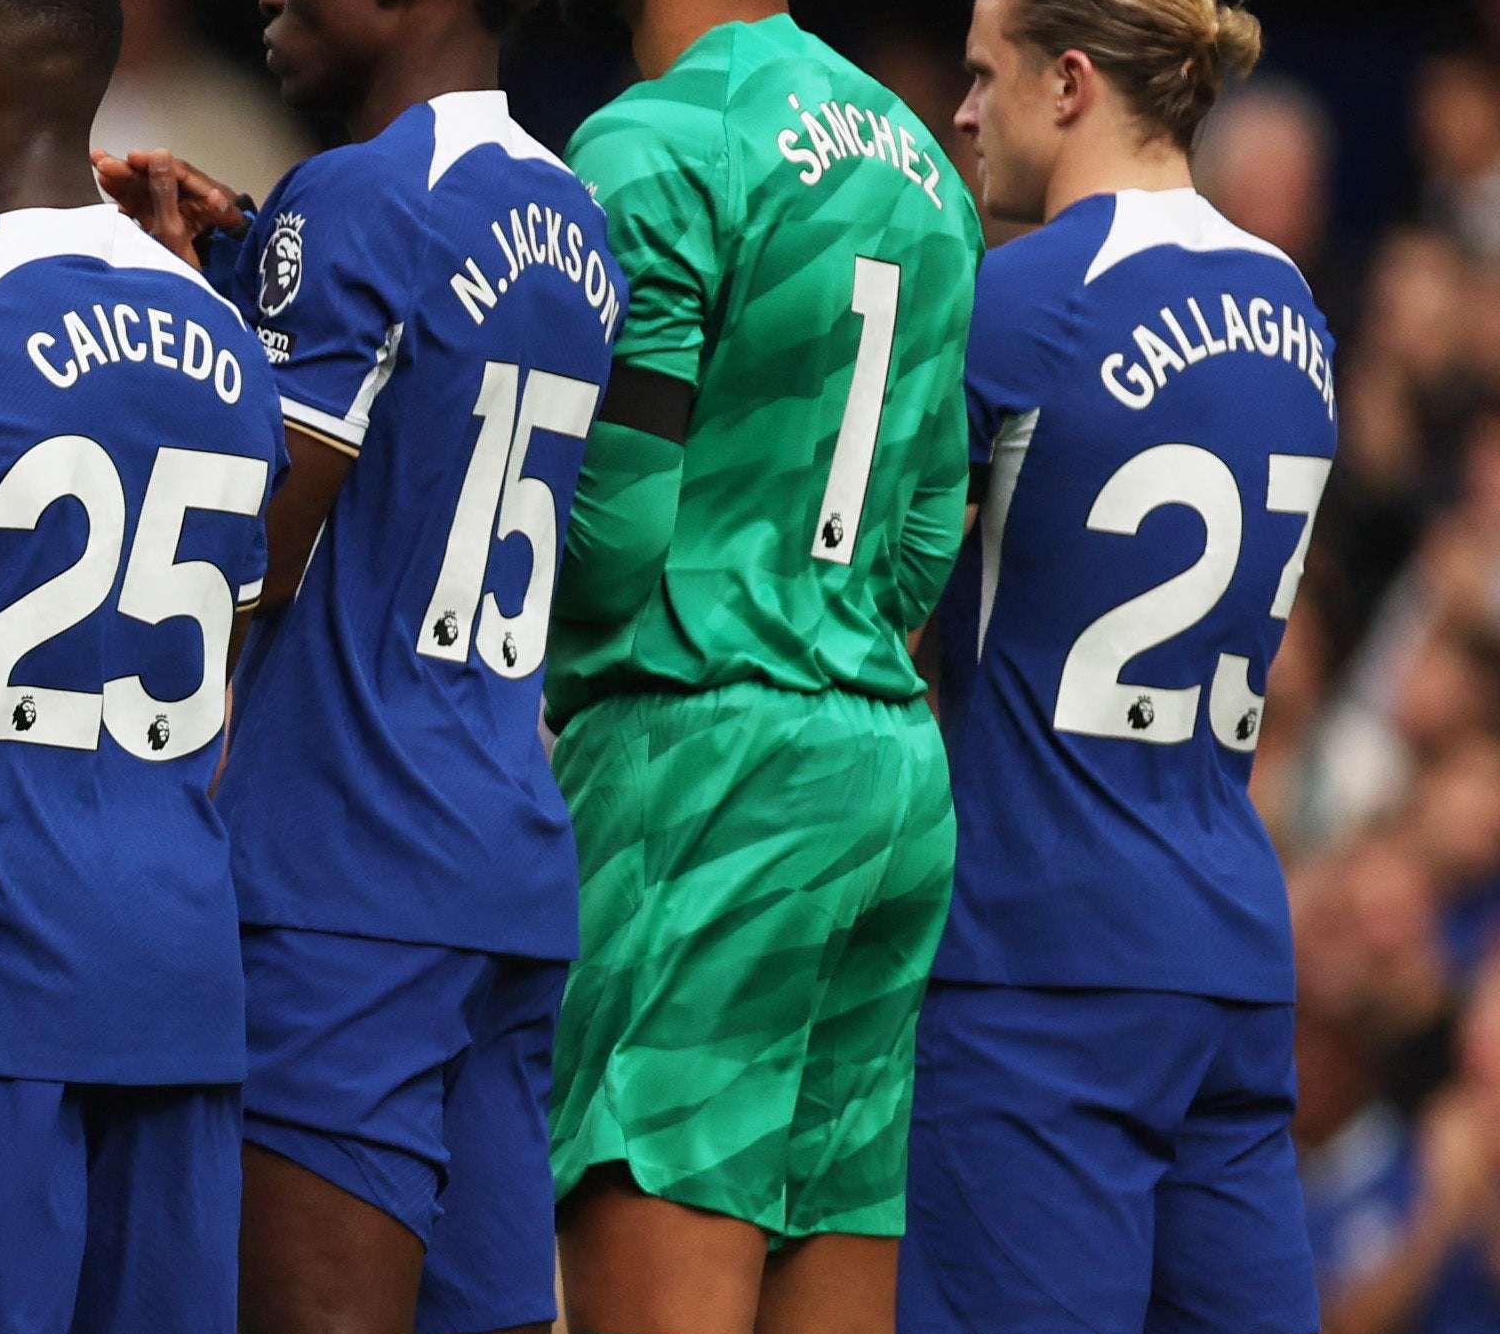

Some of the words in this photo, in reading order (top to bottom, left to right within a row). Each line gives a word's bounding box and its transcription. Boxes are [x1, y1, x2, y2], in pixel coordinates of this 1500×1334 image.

[27, 304, 242, 404] CAICEDO
[450, 202, 619, 344] N.JACKSON
[811, 255, 900, 565] 1
[416, 361, 600, 679] 15
[1053, 443, 1333, 754] 23
